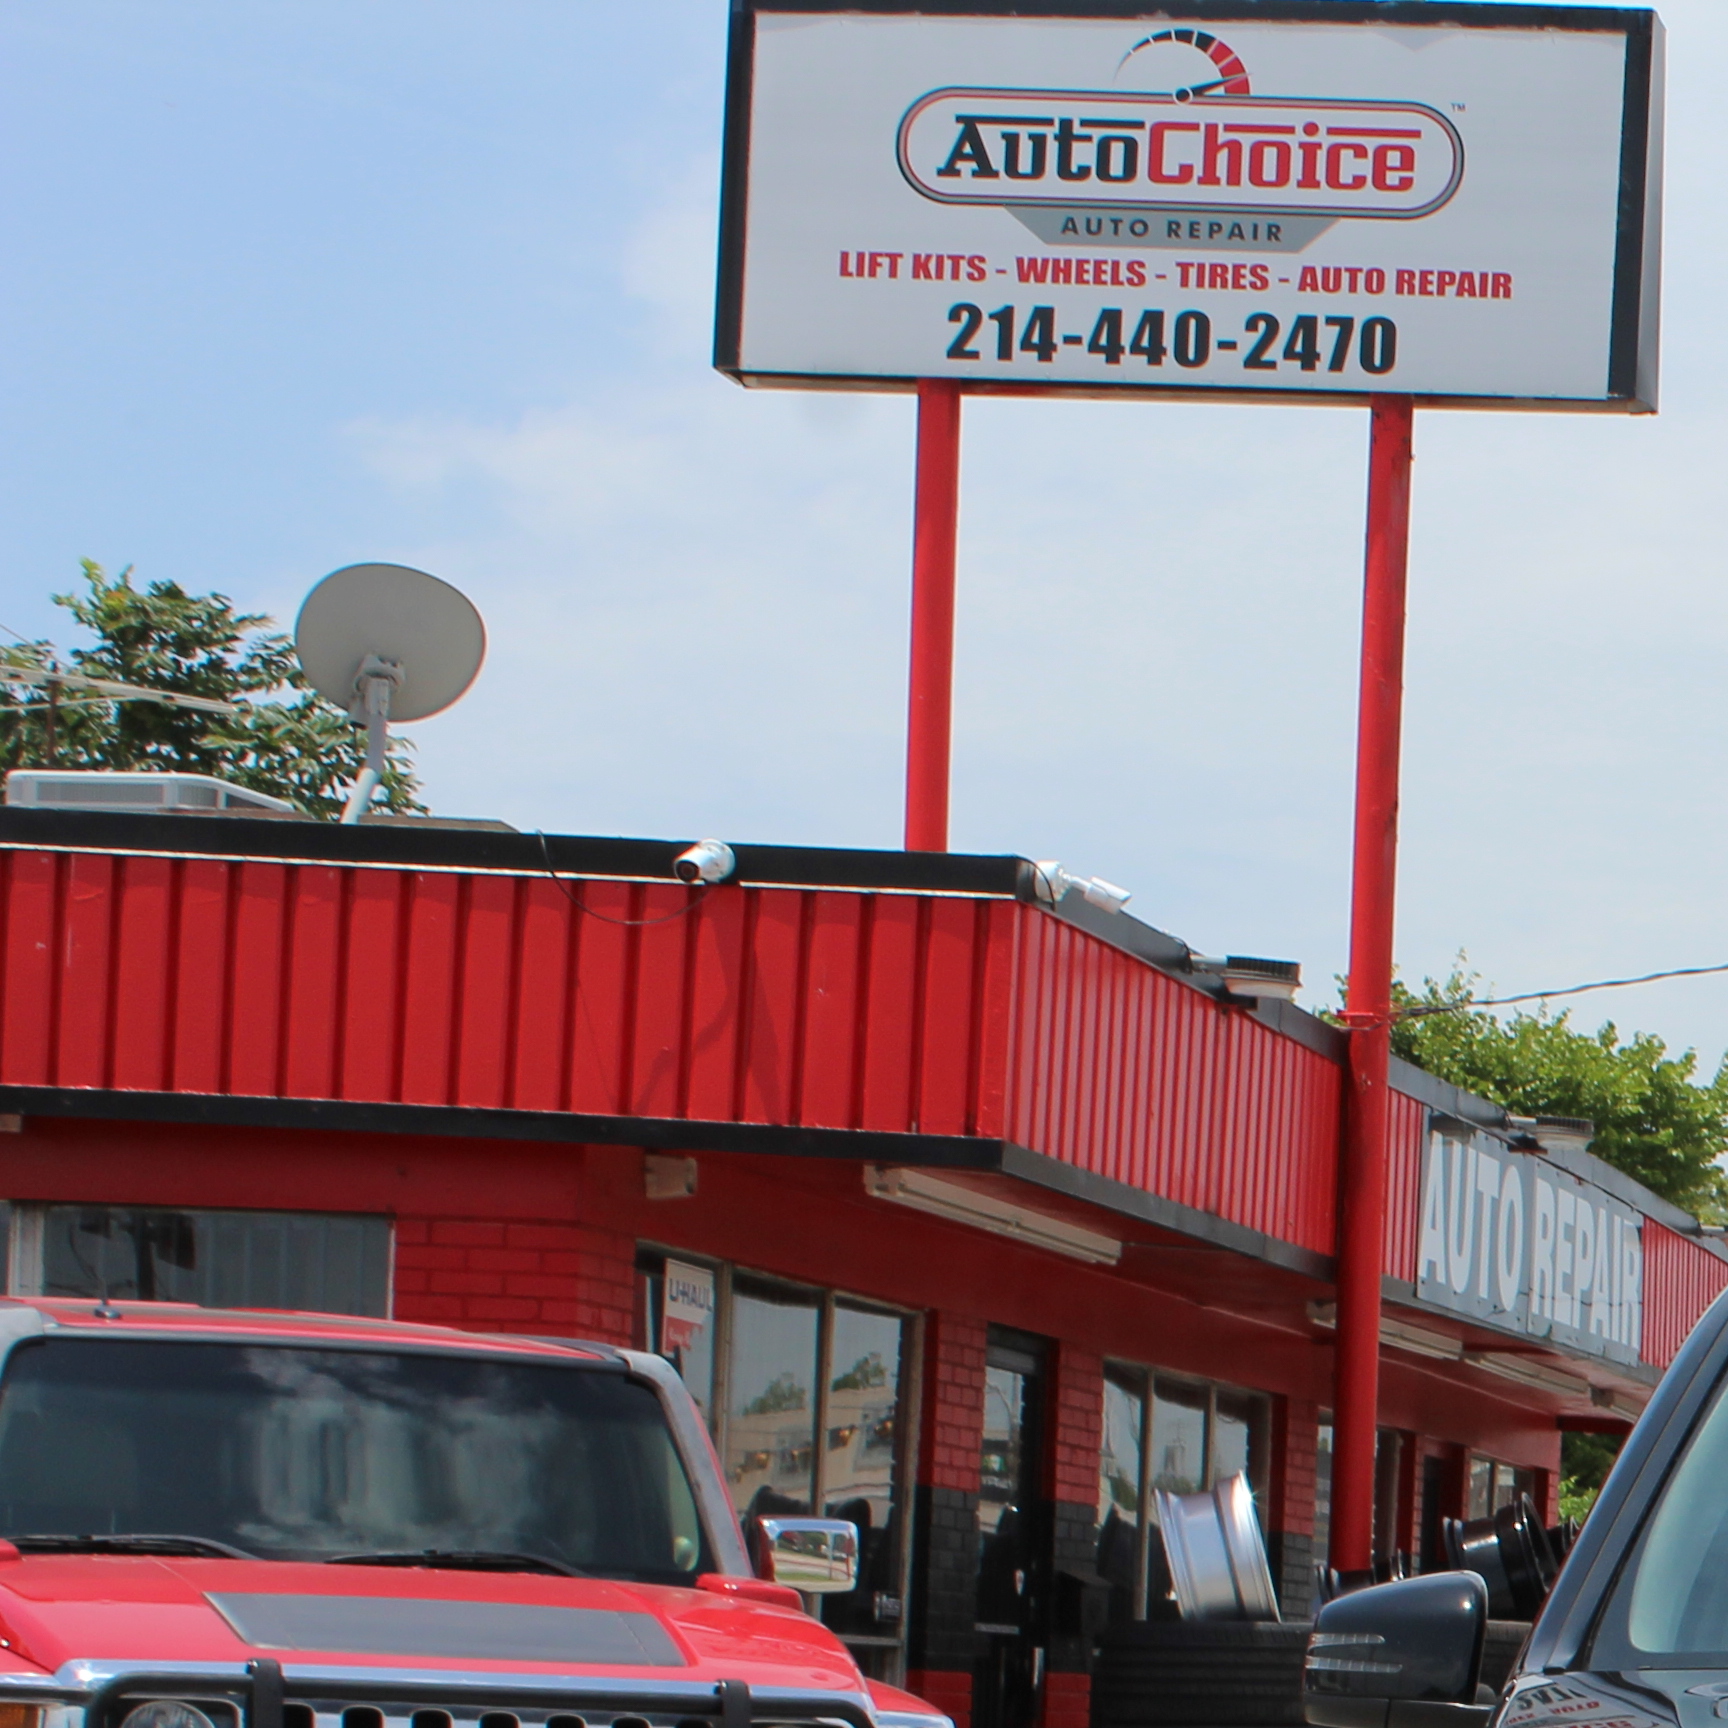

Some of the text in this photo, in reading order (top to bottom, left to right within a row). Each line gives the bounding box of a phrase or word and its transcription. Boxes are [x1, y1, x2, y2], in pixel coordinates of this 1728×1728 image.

[937, 115, 1422, 191] AutoChoice
[1061, 216, 1284, 244] AUTO REPAIR
[840, 251, 903, 278] LIFT
[913, 254, 986, 281] KITS
[1016, 257, 1145, 287] WHEELS
[1176, 262, 1268, 291] TIRES
[1298, 266, 1385, 294] AUTO
[1396, 269, 1511, 298] REPAIR
[945, 302, 1397, 375] 214-440-2470
[1419, 1129, 1643, 1349] AUTO REPAIR
